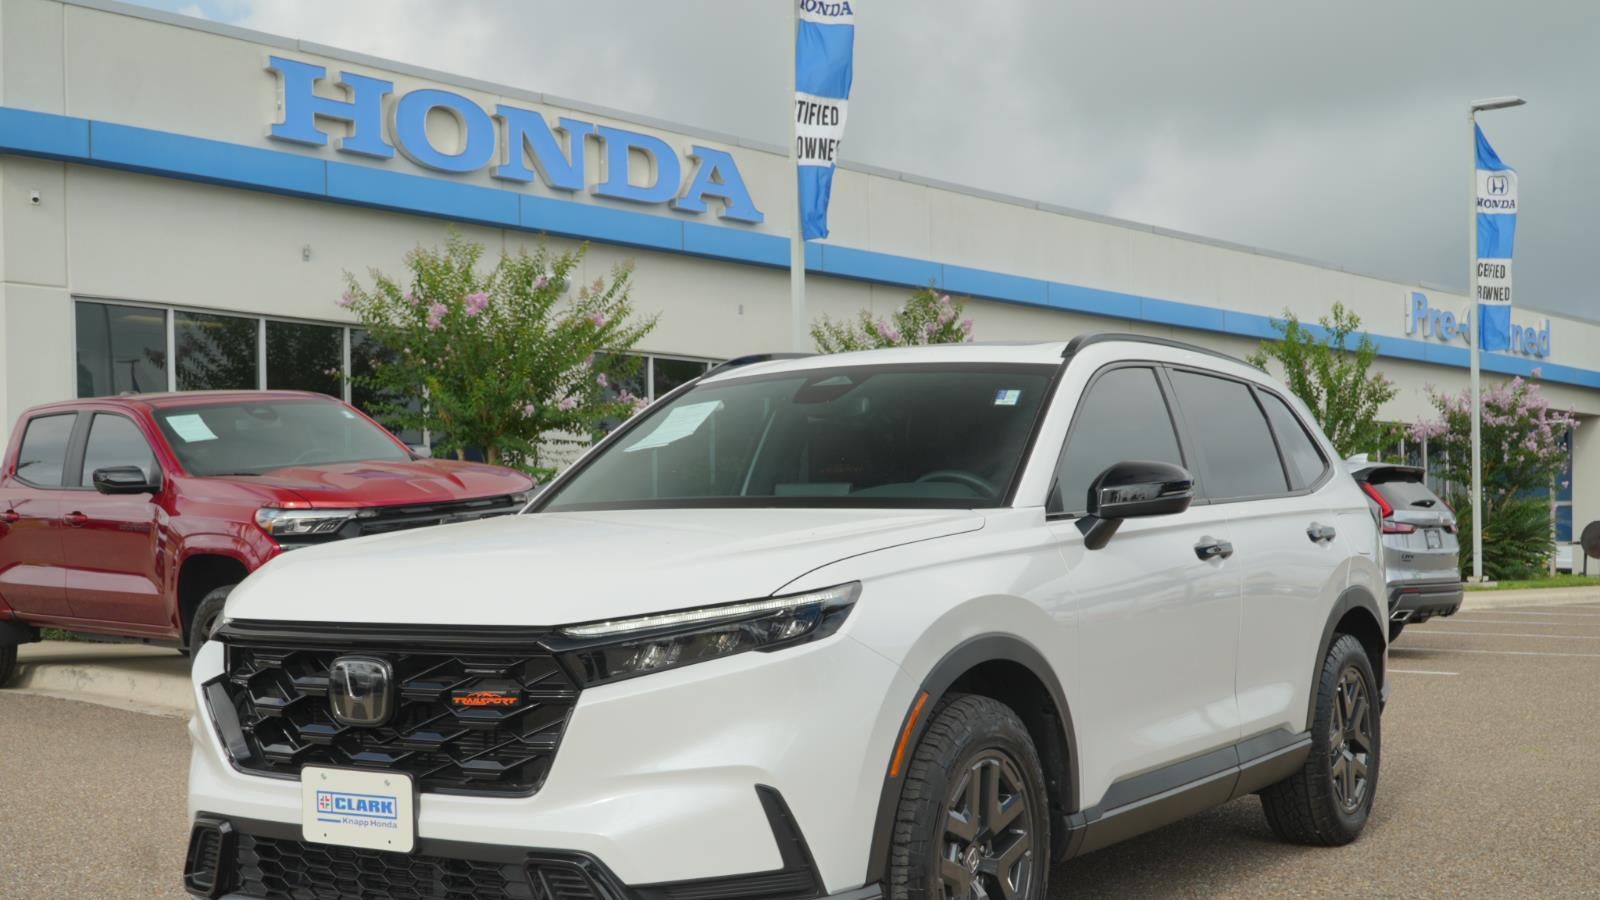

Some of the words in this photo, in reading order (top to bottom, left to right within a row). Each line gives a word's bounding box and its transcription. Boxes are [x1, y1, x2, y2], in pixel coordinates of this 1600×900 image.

[795, 100, 839, 126] TIFIED
[266, 55, 764, 223] HONDA
[797, 136, 841, 161] OWNE
[1406, 291, 1551, 356] Pre-ned
[335, 797, 393, 814] CLARK
[342, 817, 369, 827] Knapp
[370, 819, 397, 828] Honda
